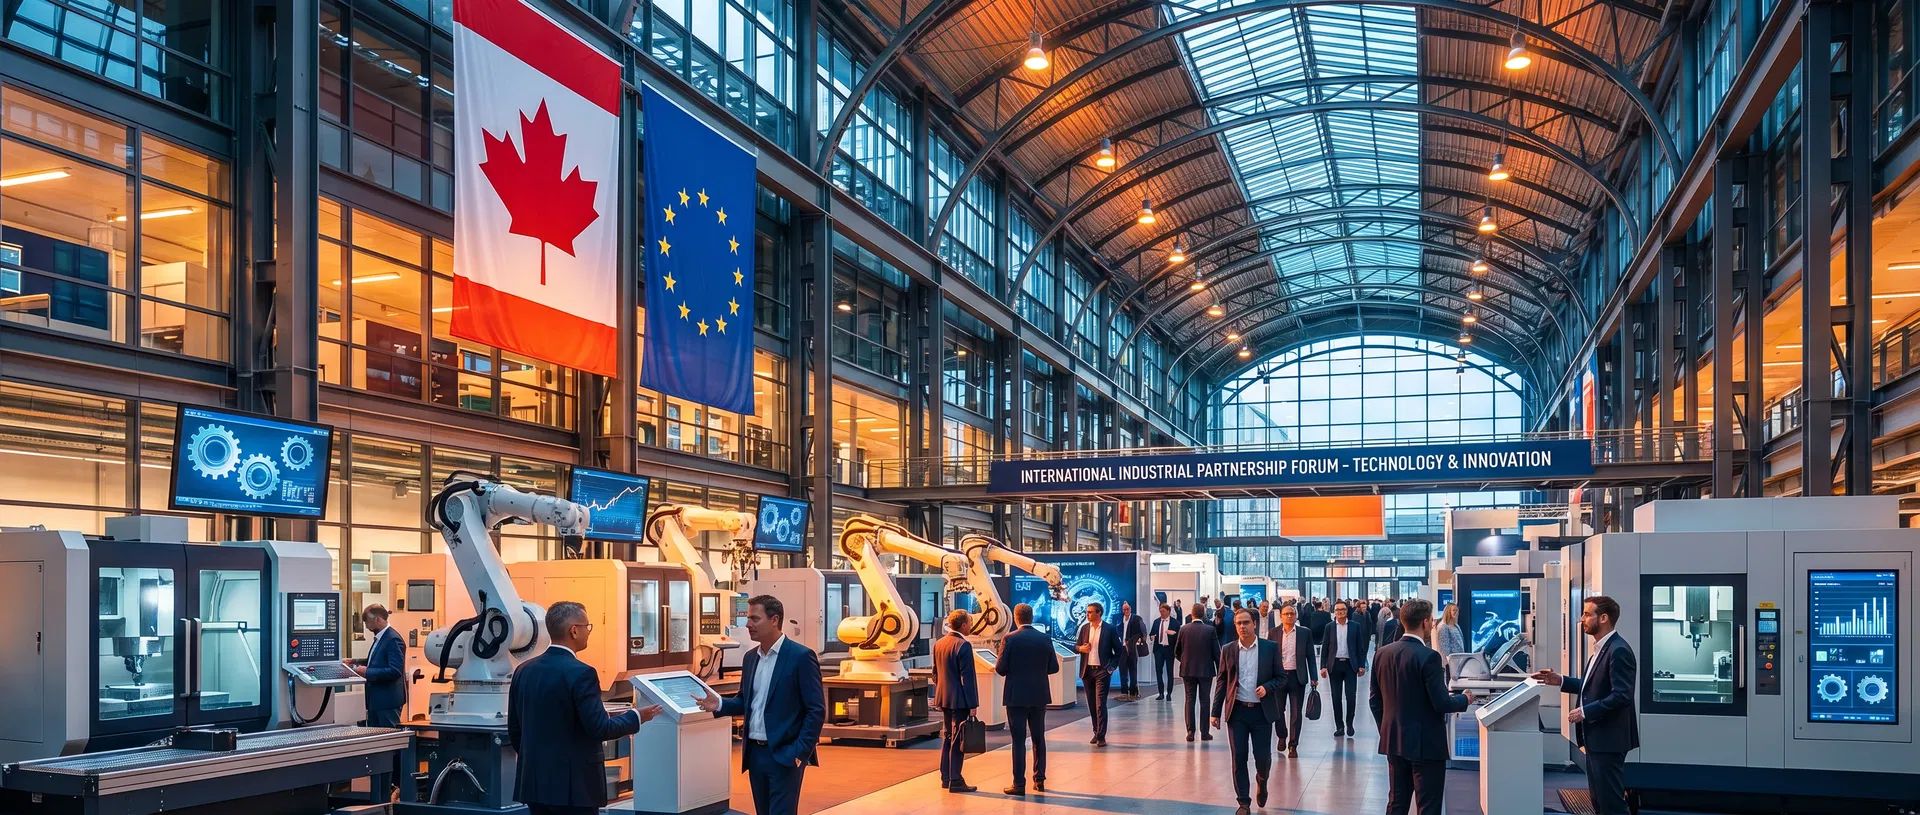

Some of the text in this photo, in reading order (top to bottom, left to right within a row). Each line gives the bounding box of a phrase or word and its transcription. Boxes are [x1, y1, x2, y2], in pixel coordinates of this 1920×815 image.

[1021, 466, 1116, 484] INTERNATIONAL
[1118, 464, 1194, 480] INDUSTRIAL
[1197, 460, 1288, 478] PARTNERSHIP
[1291, 458, 1339, 475] FORUM
[1352, 454, 1444, 472] TECHNOLOGY
[1447, 454, 1459, 470] &
[1463, 450, 1552, 468] INNOVATION
